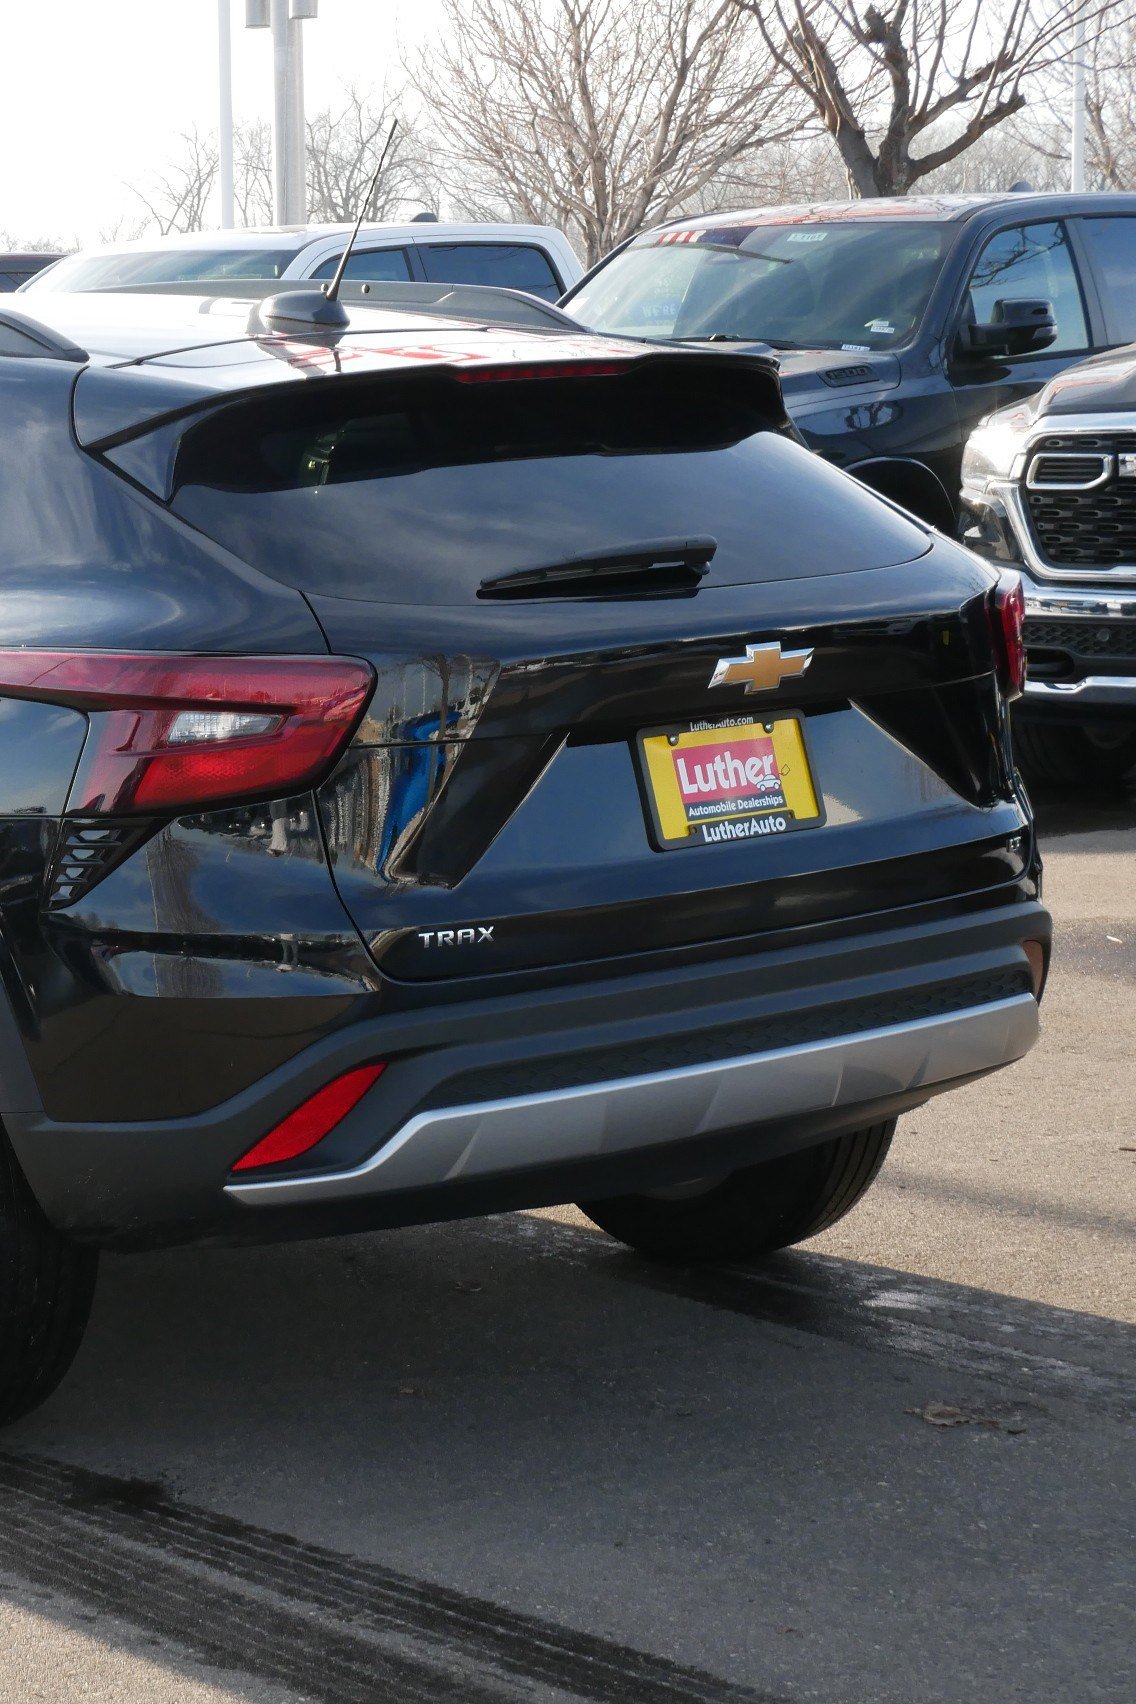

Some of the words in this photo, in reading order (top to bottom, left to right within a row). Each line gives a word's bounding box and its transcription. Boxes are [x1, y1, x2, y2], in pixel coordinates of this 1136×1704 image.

[676, 751, 774, 795] Luther
[689, 802, 737, 817] Automobile
[737, 794, 784, 810] Dealerships
[701, 815, 787, 843] LutherAuto
[418, 925, 495, 949] TRAX
